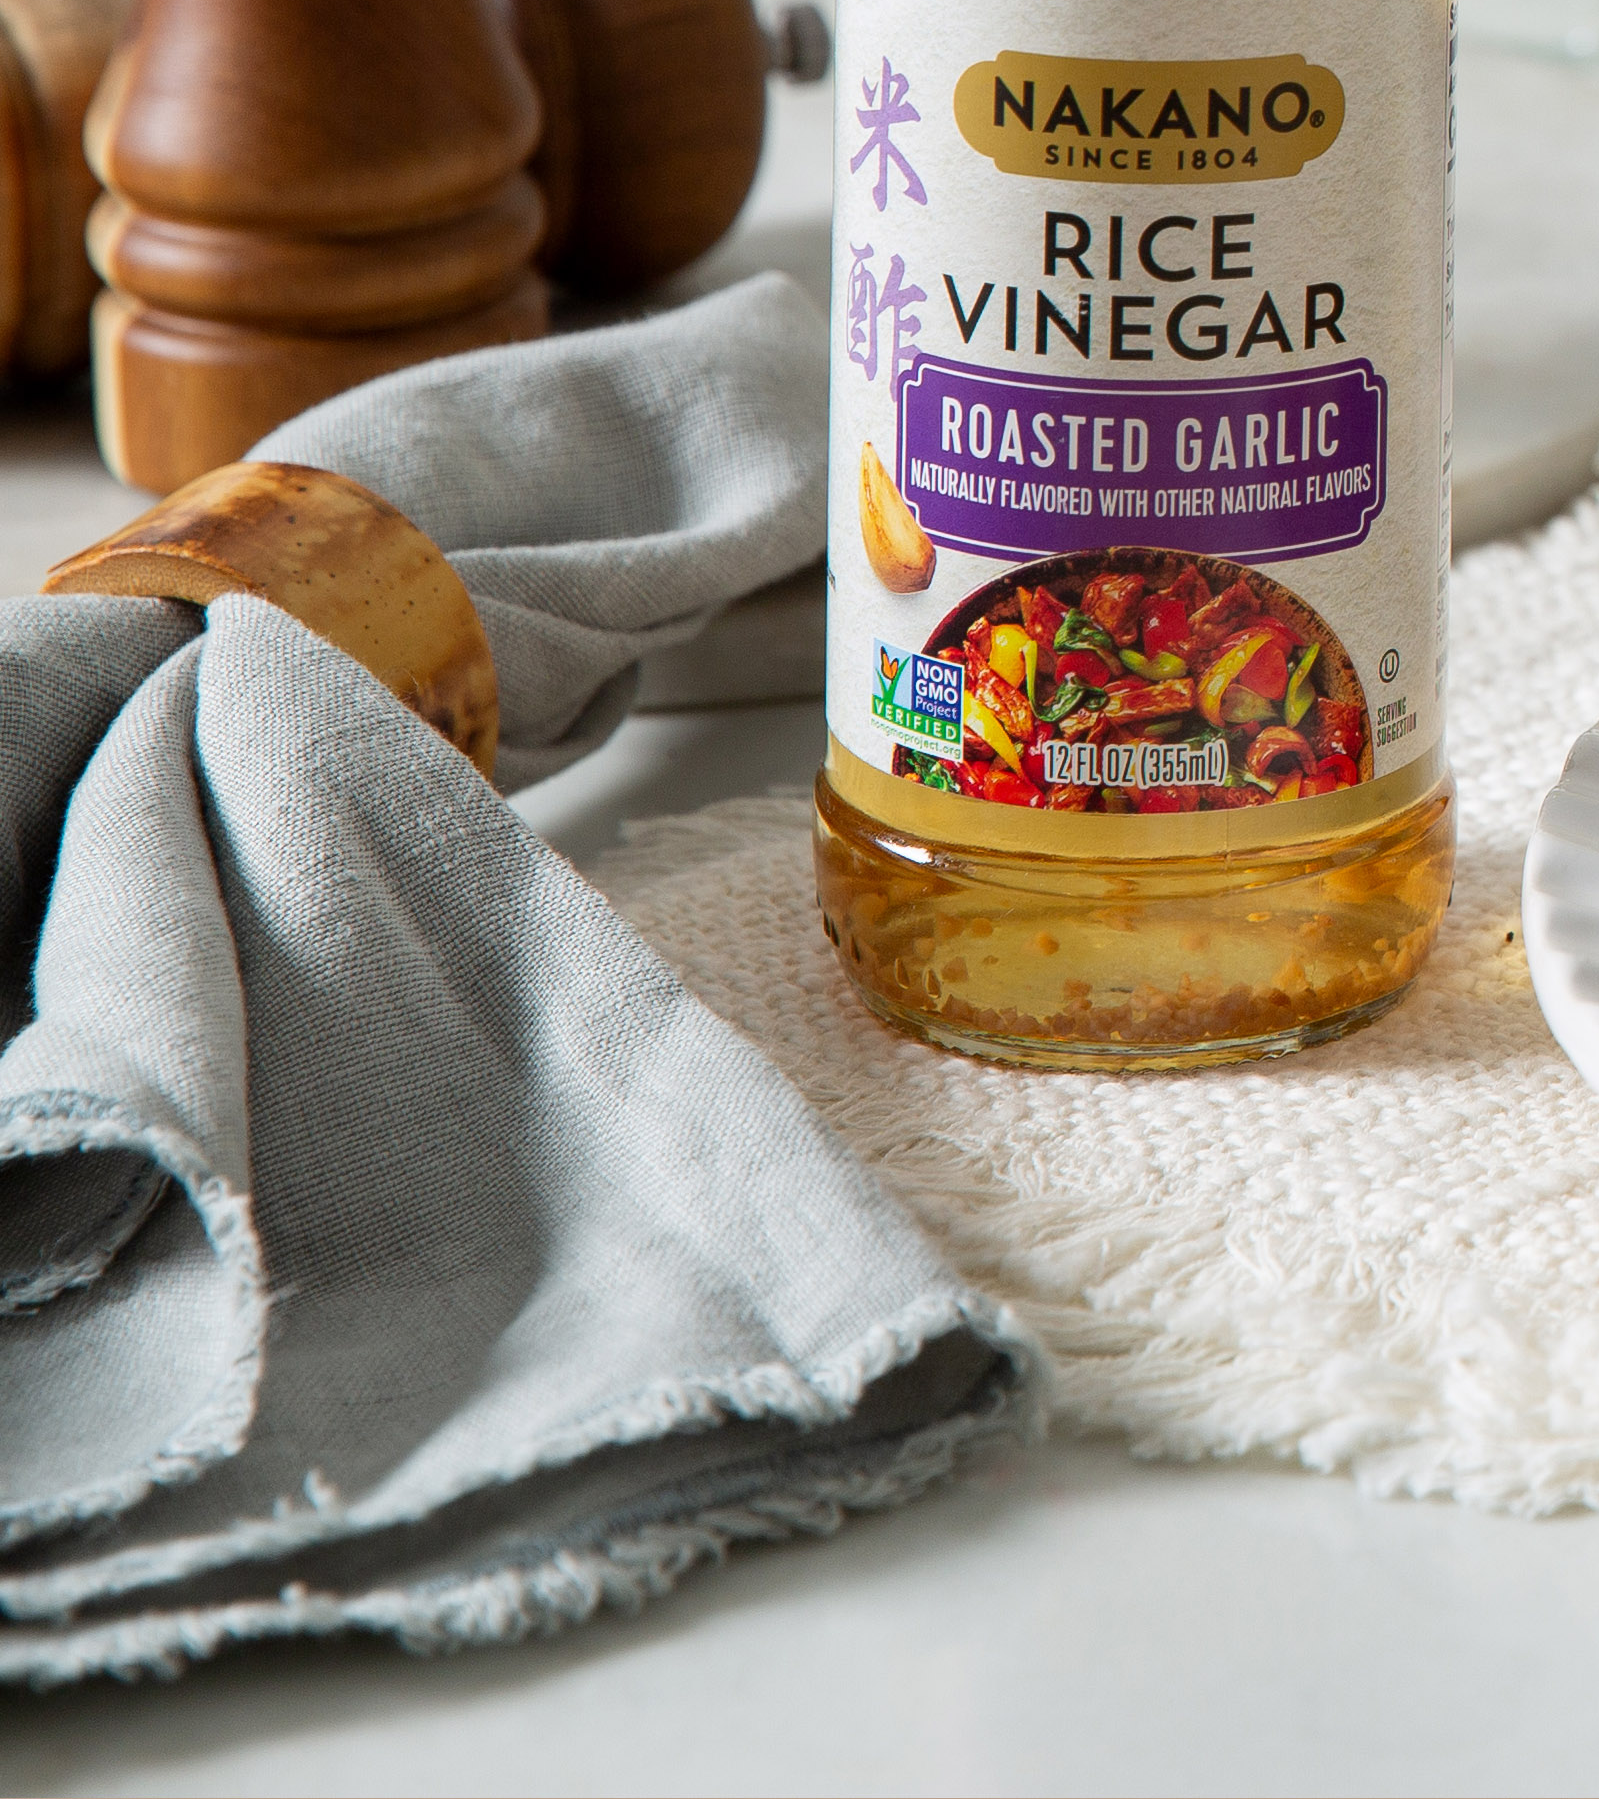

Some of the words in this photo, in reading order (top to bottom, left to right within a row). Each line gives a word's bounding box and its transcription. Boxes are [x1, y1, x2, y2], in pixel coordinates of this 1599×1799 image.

[1045, 144, 1153, 171] SINCE
[1177, 146, 1259, 171] 1804
[1043, 210, 1255, 283] RICE
[942, 273, 1347, 362] VINEGAR
[941, 395, 1149, 473] ROASTED
[1175, 402, 1339, 473] GARLIC
[910, 457, 996, 505] NATURALLY
[1000, 478, 1093, 516] FLAVORED
[1099, 488, 1148, 518] WITH
[1153, 488, 1215, 517] OTHER
[1220, 478, 1302, 515] NATURAL
[1305, 463, 1372, 505] FLAVORS
[915, 678, 959, 705] GMO
[916, 659, 958, 687] NON
[874, 698, 957, 741] VERIFIED
[915, 695, 957, 720] Project
[1044, 744, 1070, 780] 12
[1076, 745, 1099, 782] FL
[1106, 747, 1135, 783] OZ
[1139, 742, 1226, 787] (355mL)
